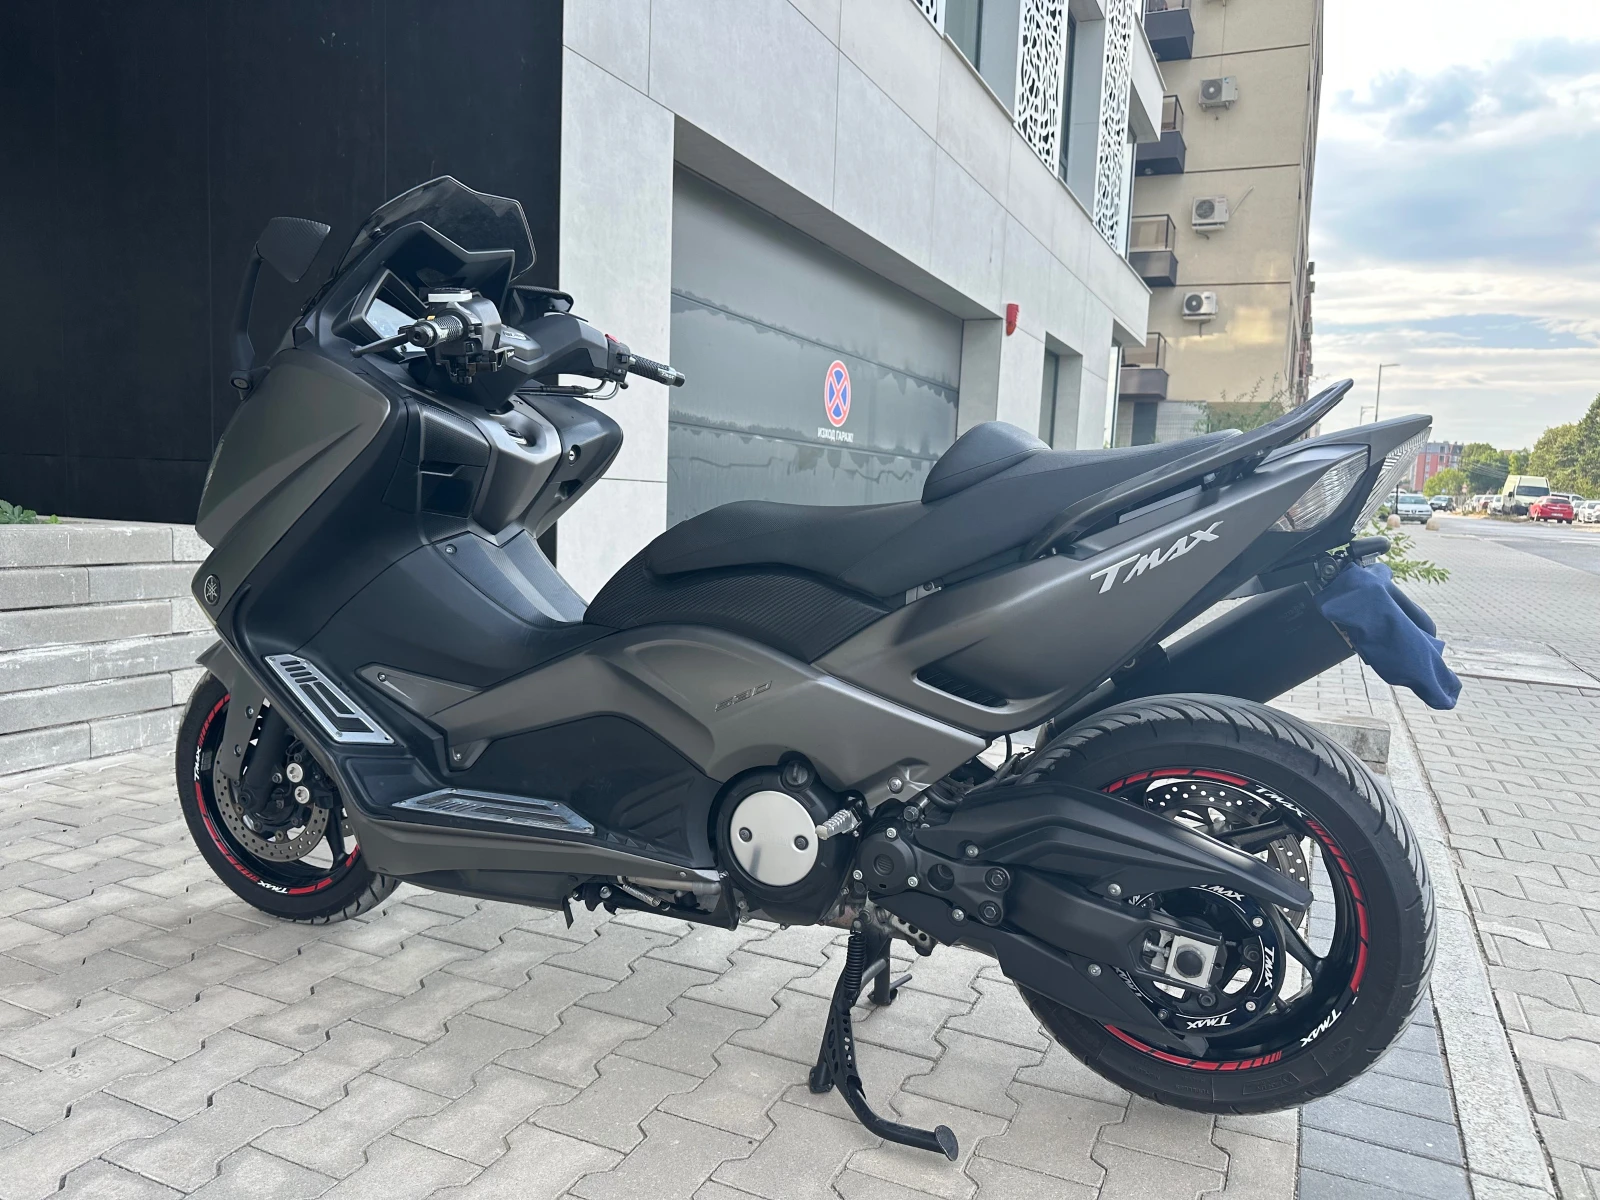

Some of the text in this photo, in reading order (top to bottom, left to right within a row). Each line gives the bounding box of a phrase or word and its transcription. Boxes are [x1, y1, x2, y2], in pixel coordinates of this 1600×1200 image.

[1090, 520, 1224, 594] TMAX
[1255, 784, 1308, 818] TMAX
[1264, 946, 1275, 990] TMAX
[1186, 1015, 1231, 1030] TMAX
[1300, 1008, 1342, 1048] TMAX
